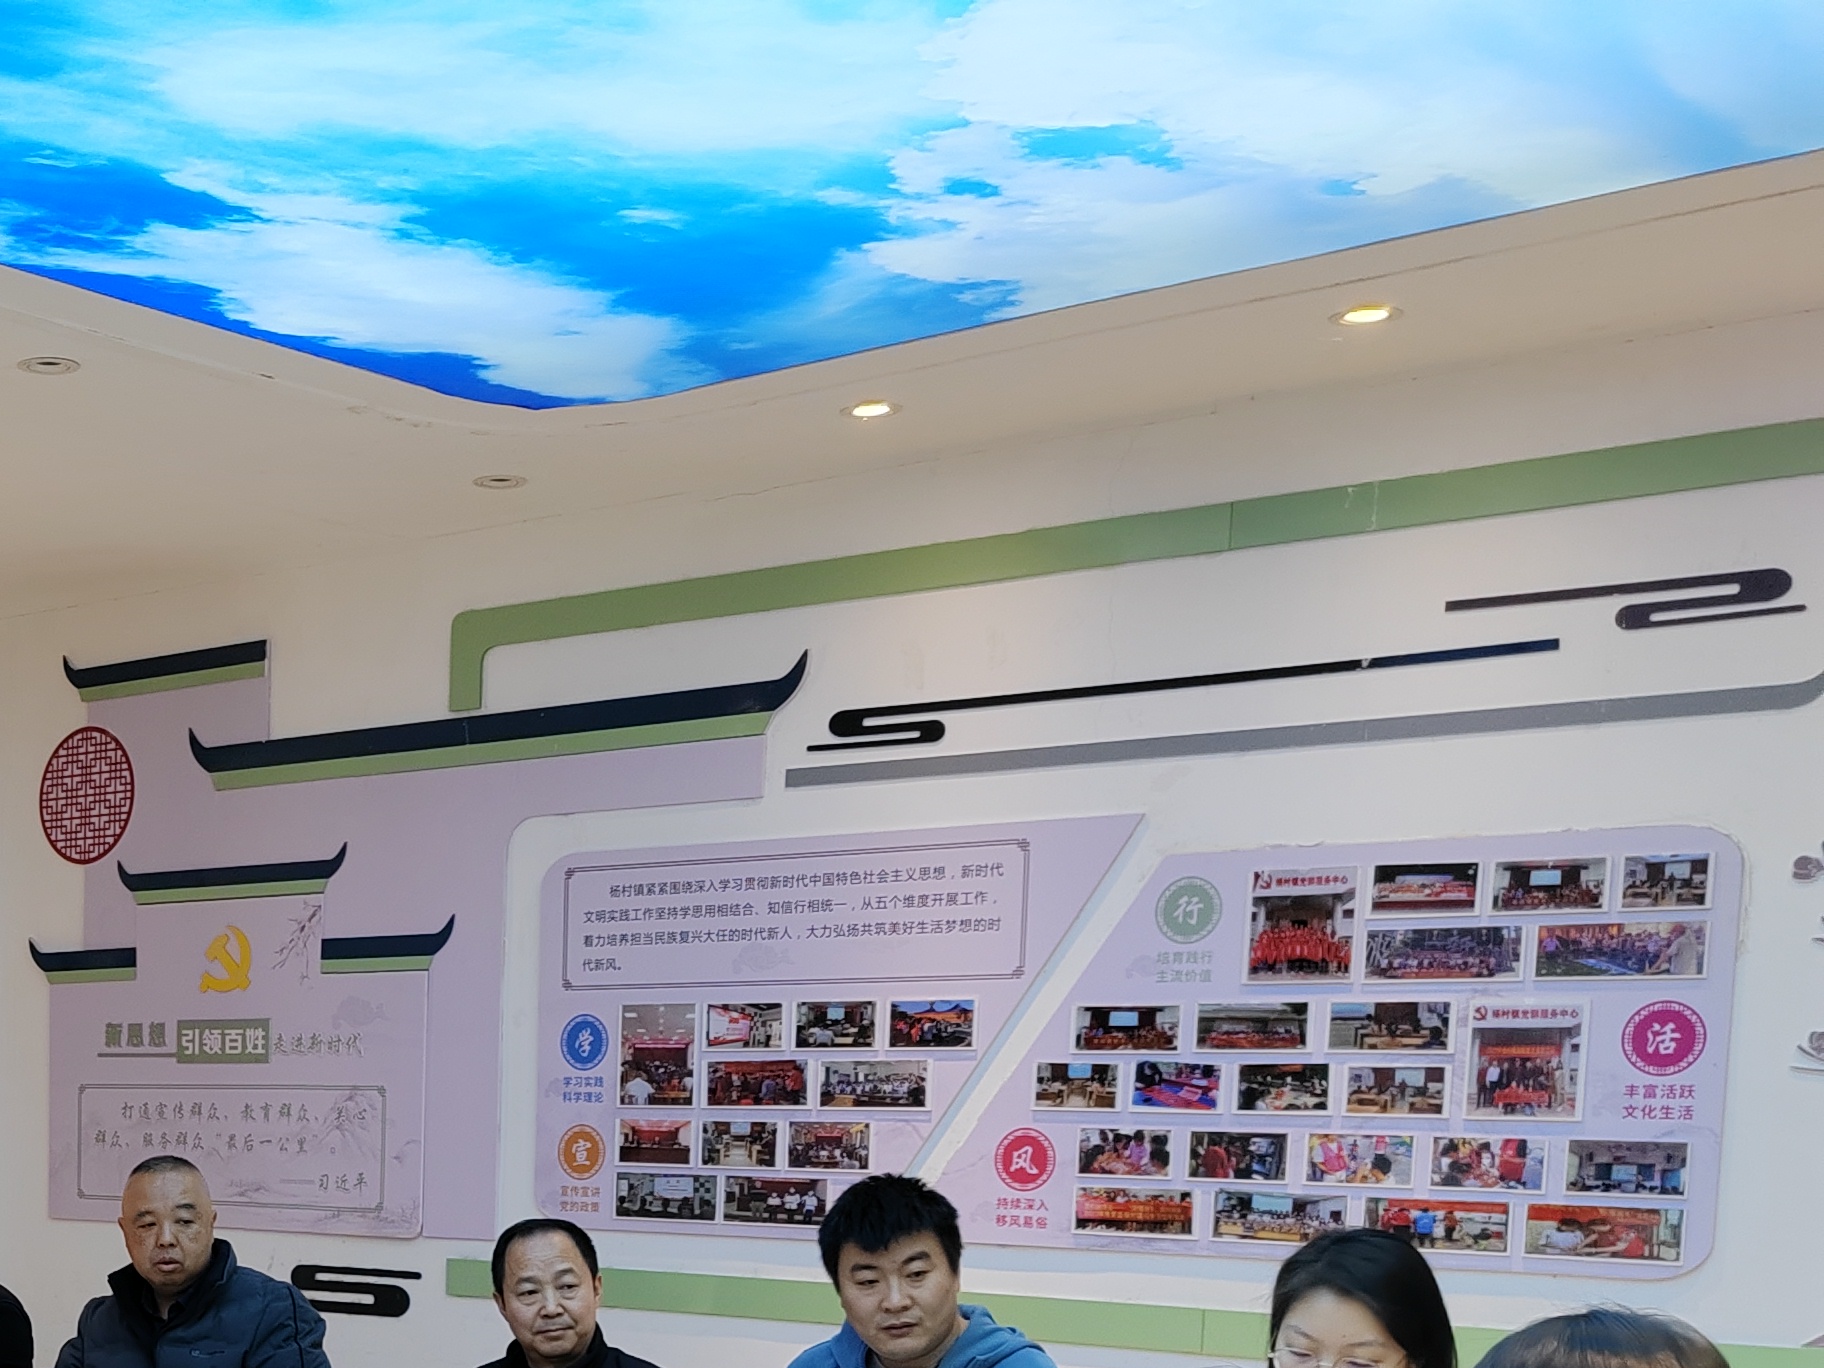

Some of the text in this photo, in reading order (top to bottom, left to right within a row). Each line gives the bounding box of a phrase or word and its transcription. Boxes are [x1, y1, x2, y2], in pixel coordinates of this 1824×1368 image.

[609, 862, 1004, 898] 杨村镇紧紧围绕深入学习贯彻新时代中国特色社会主义思想，新时代
[1173, 895, 1204, 925] 行
[583, 917, 1002, 948] 着力培养担当民族复兴大任的时代新人，大力弘扬共筑美好生活梦想的时
[582, 958, 622, 972] 代新风。
[105, 1022, 364, 1057] 新思想 引领百姓 走进新时代
[575, 1027, 594, 1057] 学
[1646, 1022, 1682, 1054] 活
[563, 1076, 604, 1088] 学习实践
[563, 1091, 604, 1103] 科学理论
[1623, 1083, 1695, 1100] 丰富活跃
[1622, 1104, 1694, 1120] 文化生活
[572, 1139, 592, 1166] 宣
[1009, 1145, 1039, 1174] 风
[560, 1186, 601, 1198] 宣传宣讲
[559, 1201, 600, 1213] 党的政策
[995, 1197, 1049, 1211] 持续深入
[995, 1214, 1048, 1229] 移风易俗
